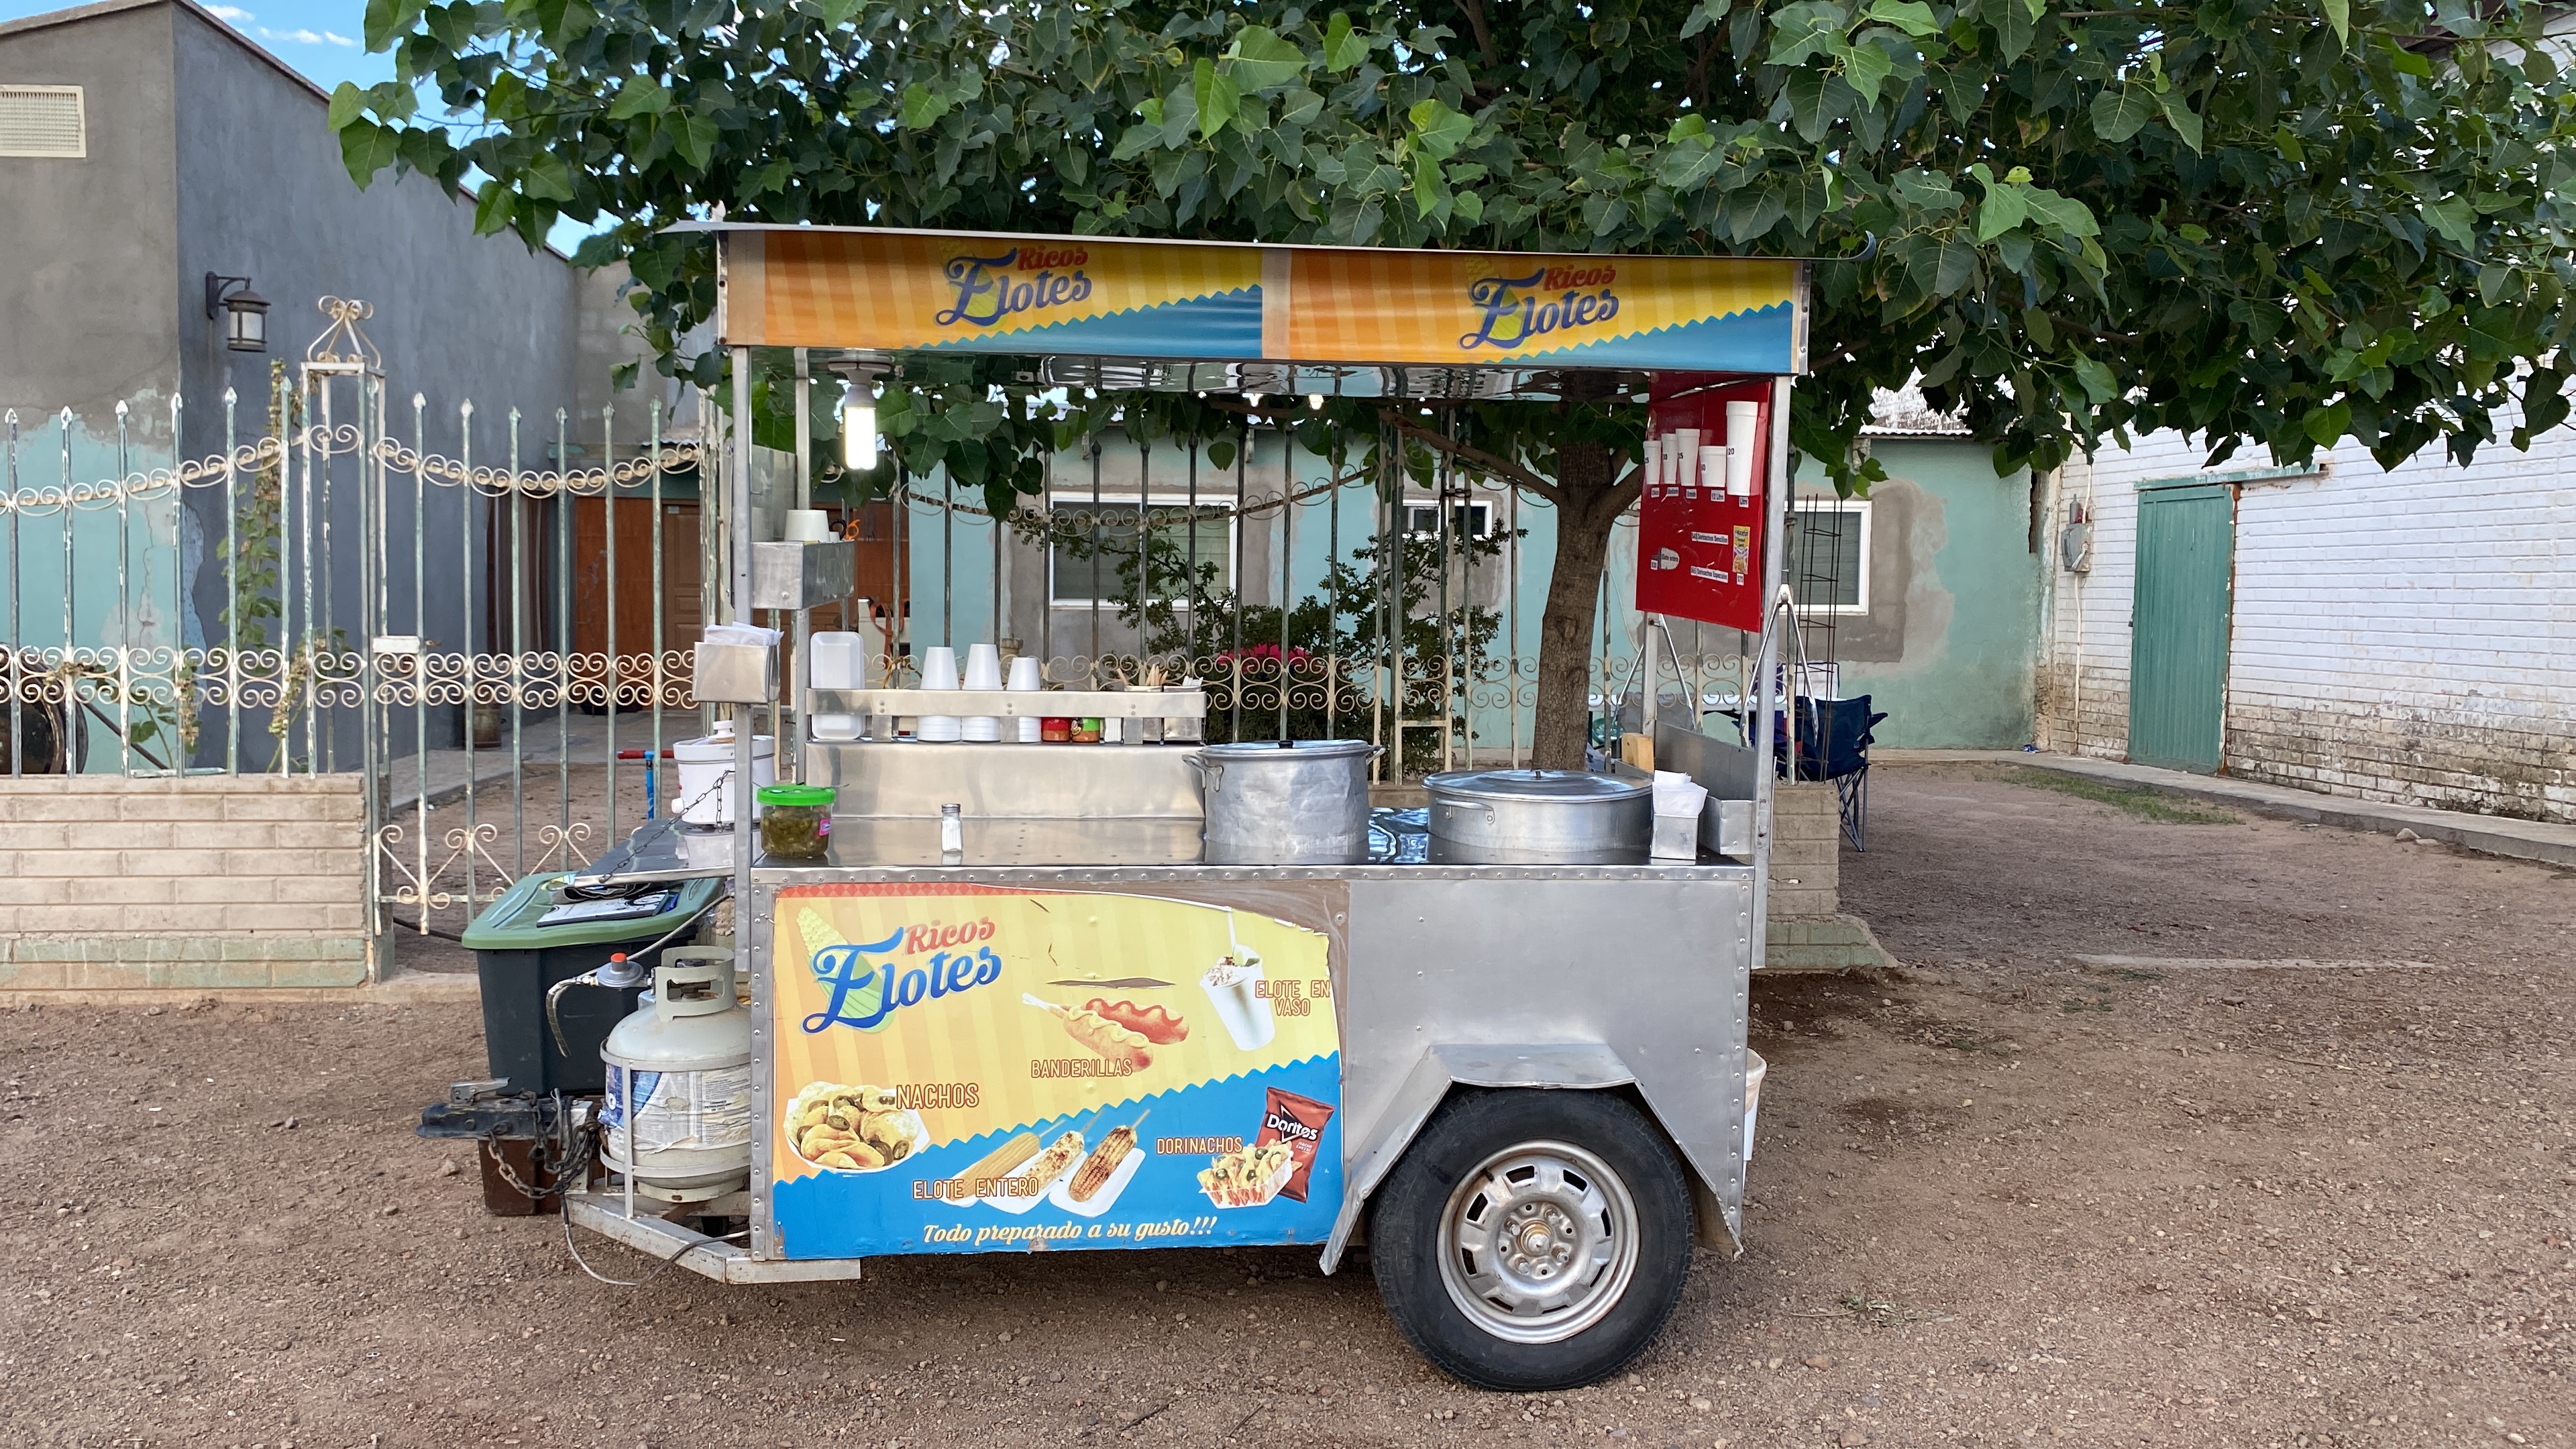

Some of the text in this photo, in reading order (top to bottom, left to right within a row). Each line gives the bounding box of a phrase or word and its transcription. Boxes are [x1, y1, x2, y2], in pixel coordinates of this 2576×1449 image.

[1018, 246, 1088, 270] Ricos
[935, 247, 1093, 326] Elotes
[1544, 264, 1617, 291] Ricos
[1458, 268, 1620, 350] Elotes
[905, 916, 996, 955] Ricos
[802, 926, 1002, 1034] Elotes
[1255, 980, 1331, 998] ELOTE EN
[1275, 998, 1310, 1016] VASO
[1030, 1058, 1132, 1079] BANDERILLAS
[896, 1083, 979, 1110] NACHOS
[1266, 1114, 1318, 1140] Doritos
[1156, 1136, 1242, 1155] DORINACHOS
[912, 1177, 1038, 1199] ELOTE ENTERO
[923, 1216, 1218, 1247] Todo preparado a su gusto!!!
